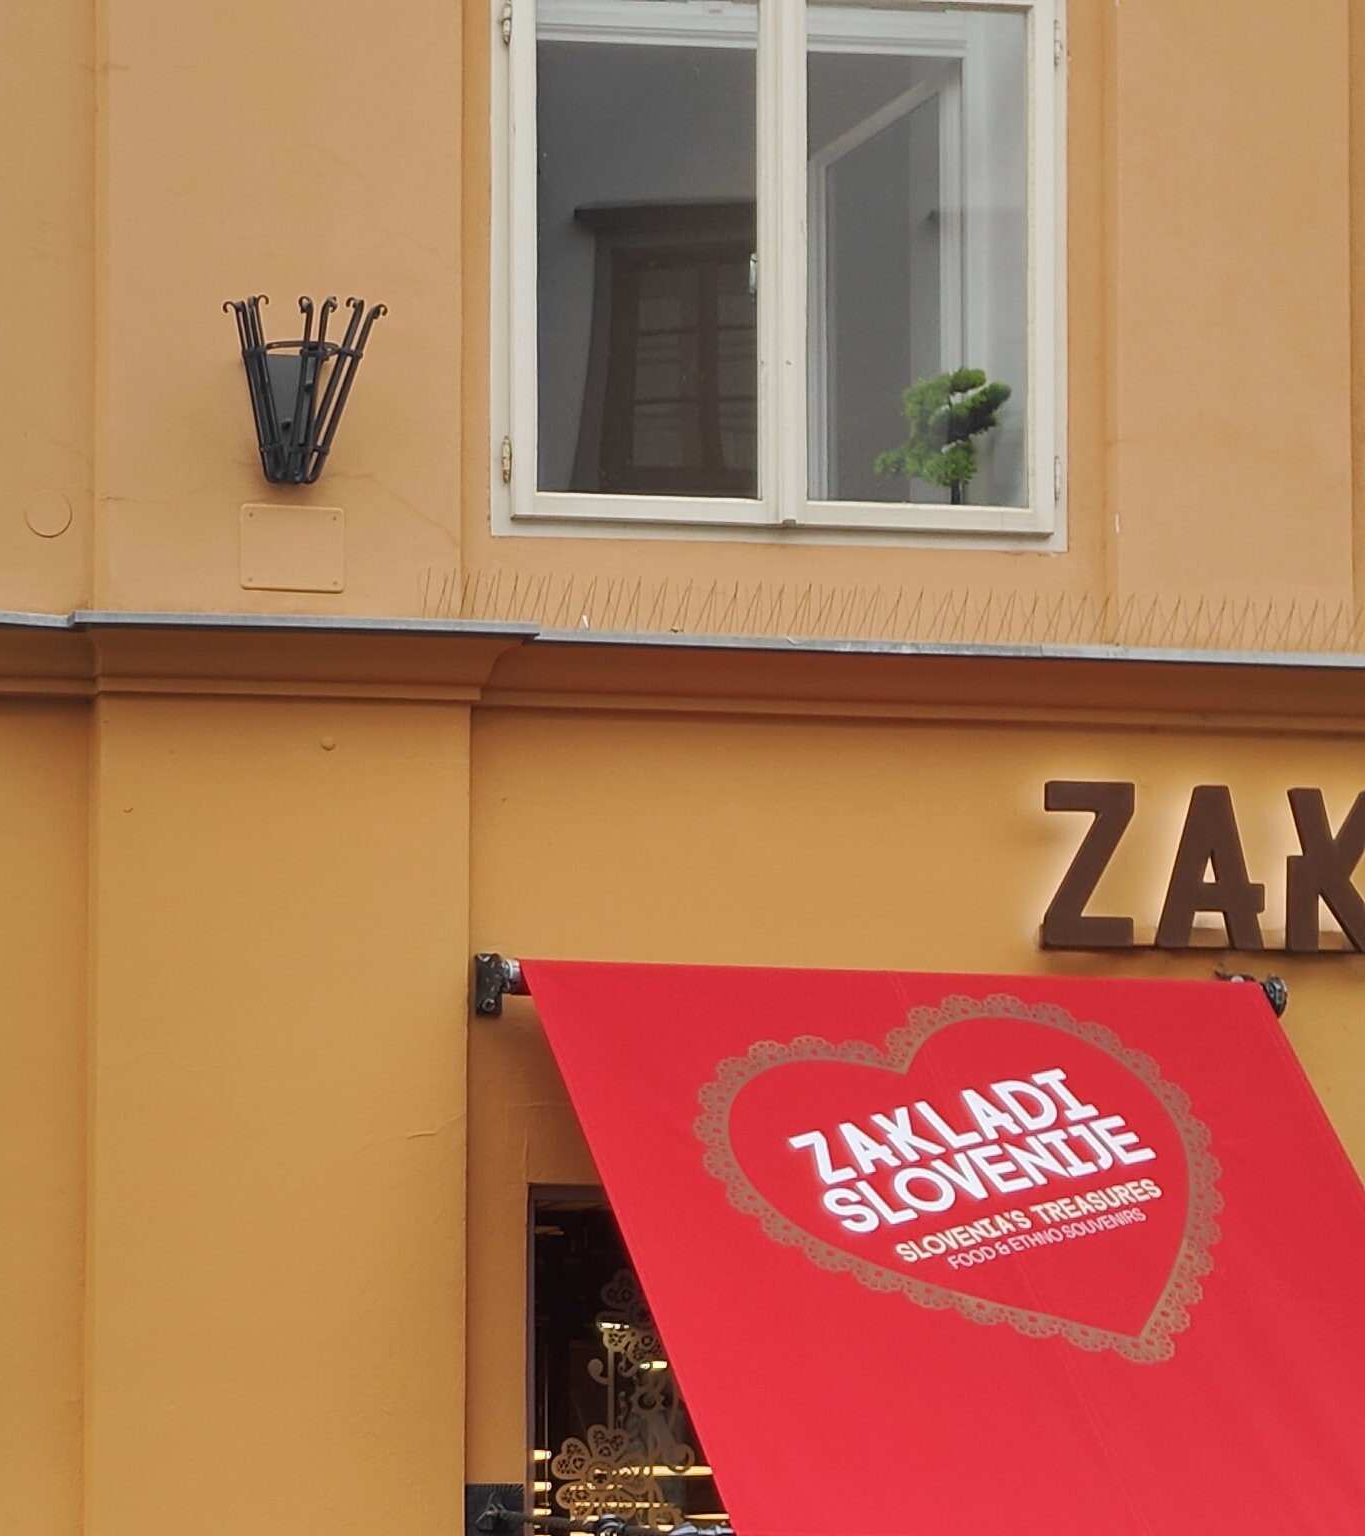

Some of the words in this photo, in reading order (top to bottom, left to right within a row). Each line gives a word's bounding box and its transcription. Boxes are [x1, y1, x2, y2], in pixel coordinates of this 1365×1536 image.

[788, 1068, 1099, 1185] ZAKLADI
[823, 1115, 1157, 1232] SLOVENIJE
[895, 1209, 1032, 1263] SLOVENIA'S
[1030, 1178, 1162, 1224] TREASURES
[947, 1245, 996, 1270] FOOD
[995, 1241, 1011, 1256] &
[1008, 1224, 1064, 1252] ETHNO
[1061, 1207, 1146, 1239] SOUVENIRS
